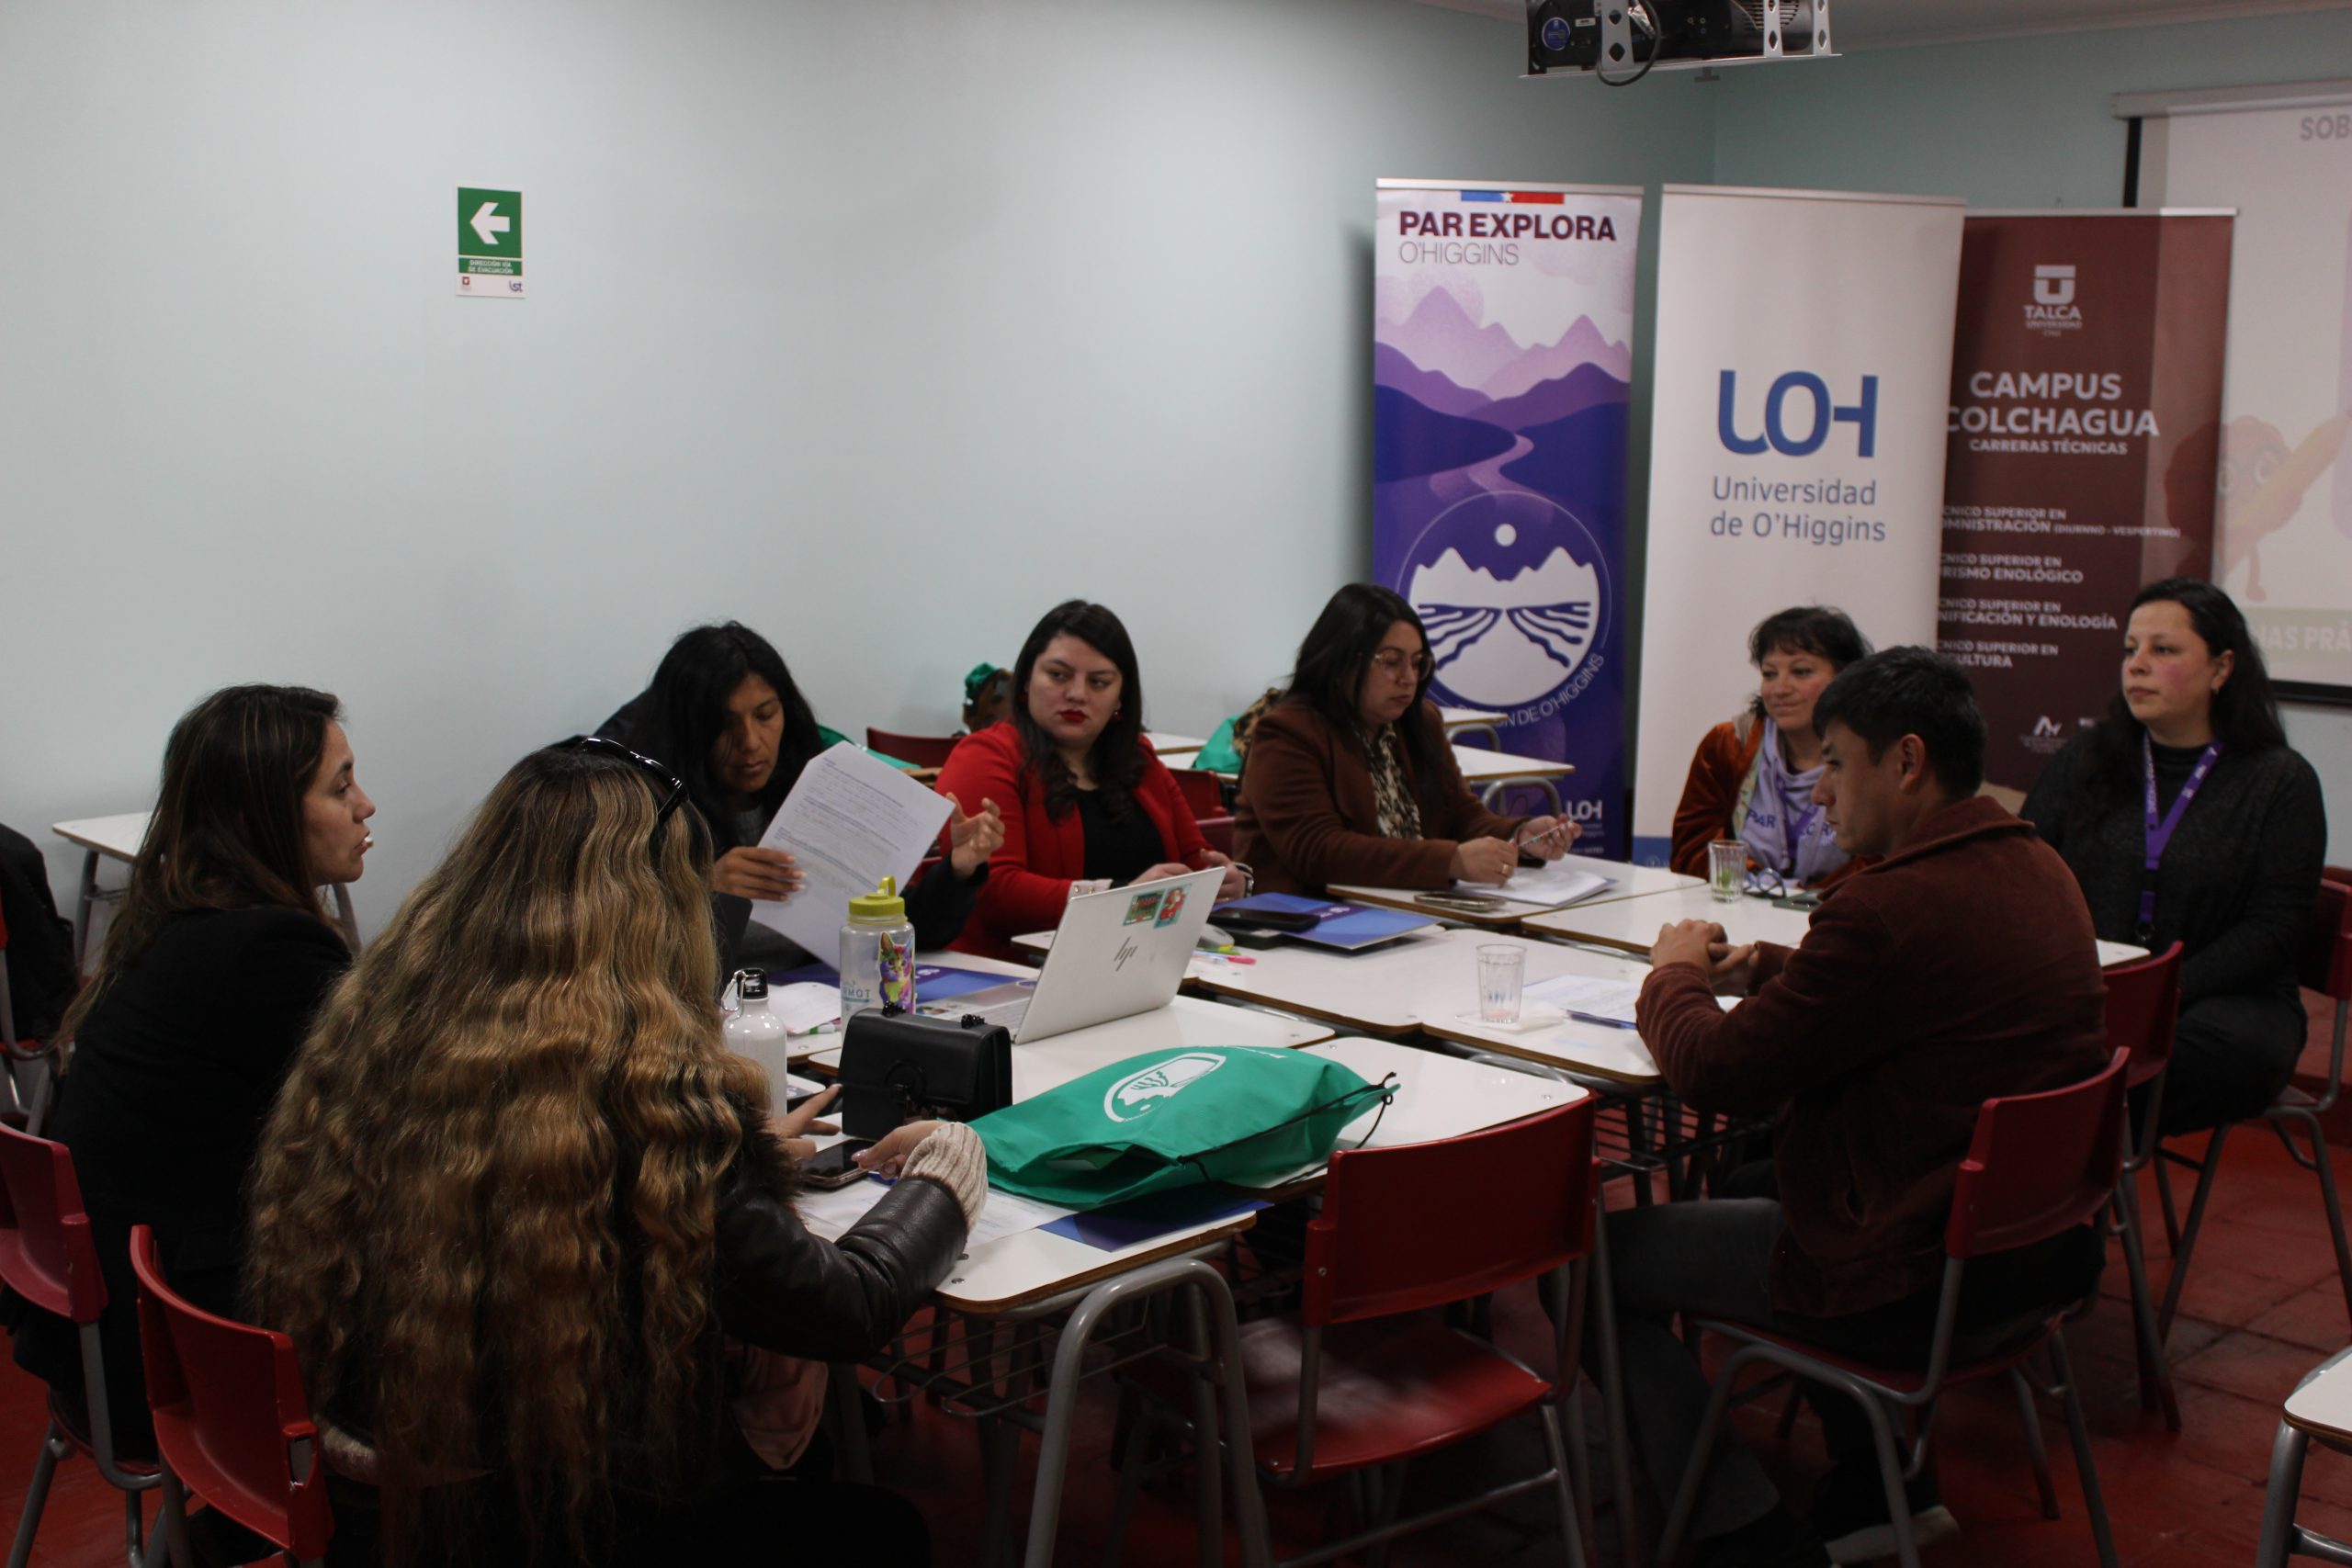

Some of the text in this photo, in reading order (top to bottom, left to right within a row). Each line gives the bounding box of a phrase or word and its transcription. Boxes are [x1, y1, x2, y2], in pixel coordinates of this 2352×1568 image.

[2300, 115, 2350, 141] SOB
[1399, 211, 1617, 242] PAR EXPLORA
[1399, 242, 1520, 266] O'HIGGINS
[2024, 305, 2082, 321] TALCA
[1970, 371, 2122, 400] CAMPUS
[1947, 406, 2160, 437] COLCHAGUA
[1970, 437, 2128, 456] CARRERAS TÉCNICAS
[1713, 475, 1877, 506] Universidad
[1943, 506, 2067, 520] CNICO SUPERIOR EN
[1711, 510, 1886, 547] de O'Higgins
[1941, 553, 2062, 568] CNICO SUPERIOR EN
[1943, 567, 2084, 584] RISMO ENOLÓGICO
[1939, 598, 2061, 613] CNICO SUPERIOR EN
[1939, 610, 2118, 630] NIFICACIÓN Y ENOLOGÍA
[2303, 619, 2352, 652] PRÁ
[1938, 640, 2058, 656] CNICO SUPERIOR EN
[1518, 706, 1541, 726] DE
[1540, 653, 1604, 717] O'HIGGINS
